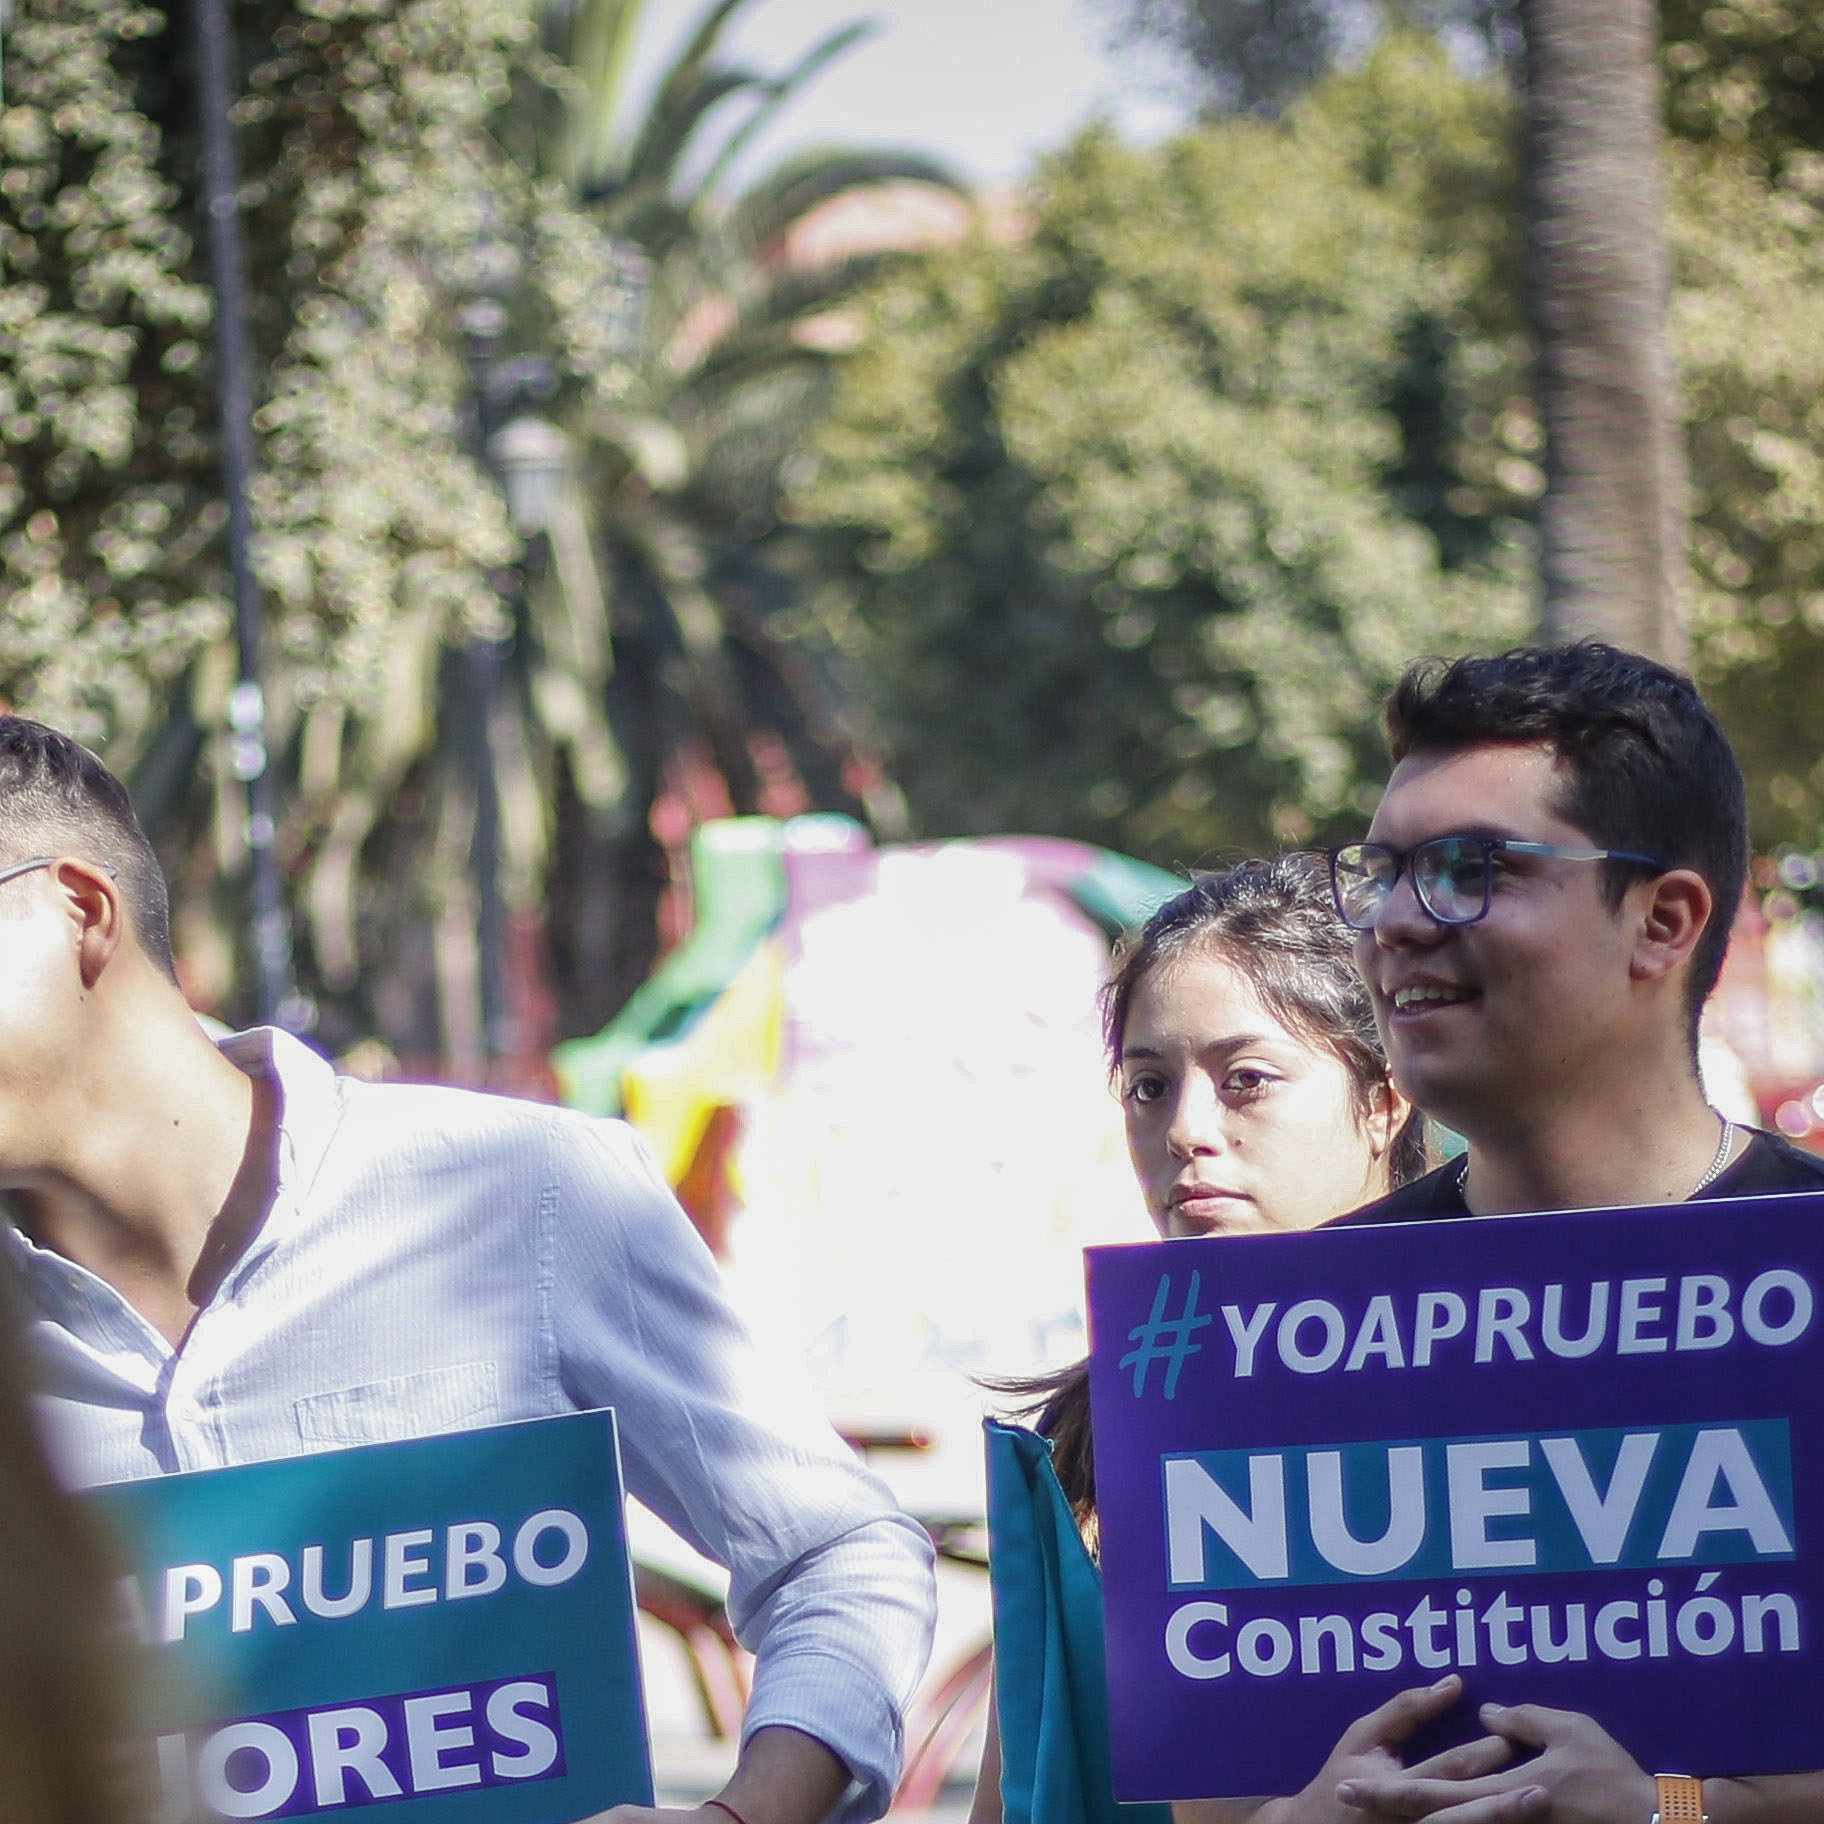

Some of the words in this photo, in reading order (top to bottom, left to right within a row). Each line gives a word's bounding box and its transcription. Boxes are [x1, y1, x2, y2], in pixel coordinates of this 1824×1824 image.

[1118, 1268, 1814, 1399] #YOAPRUEBO
[1164, 1428, 1795, 1584] NUEVA
[1164, 1572, 1801, 1680] Constitución
